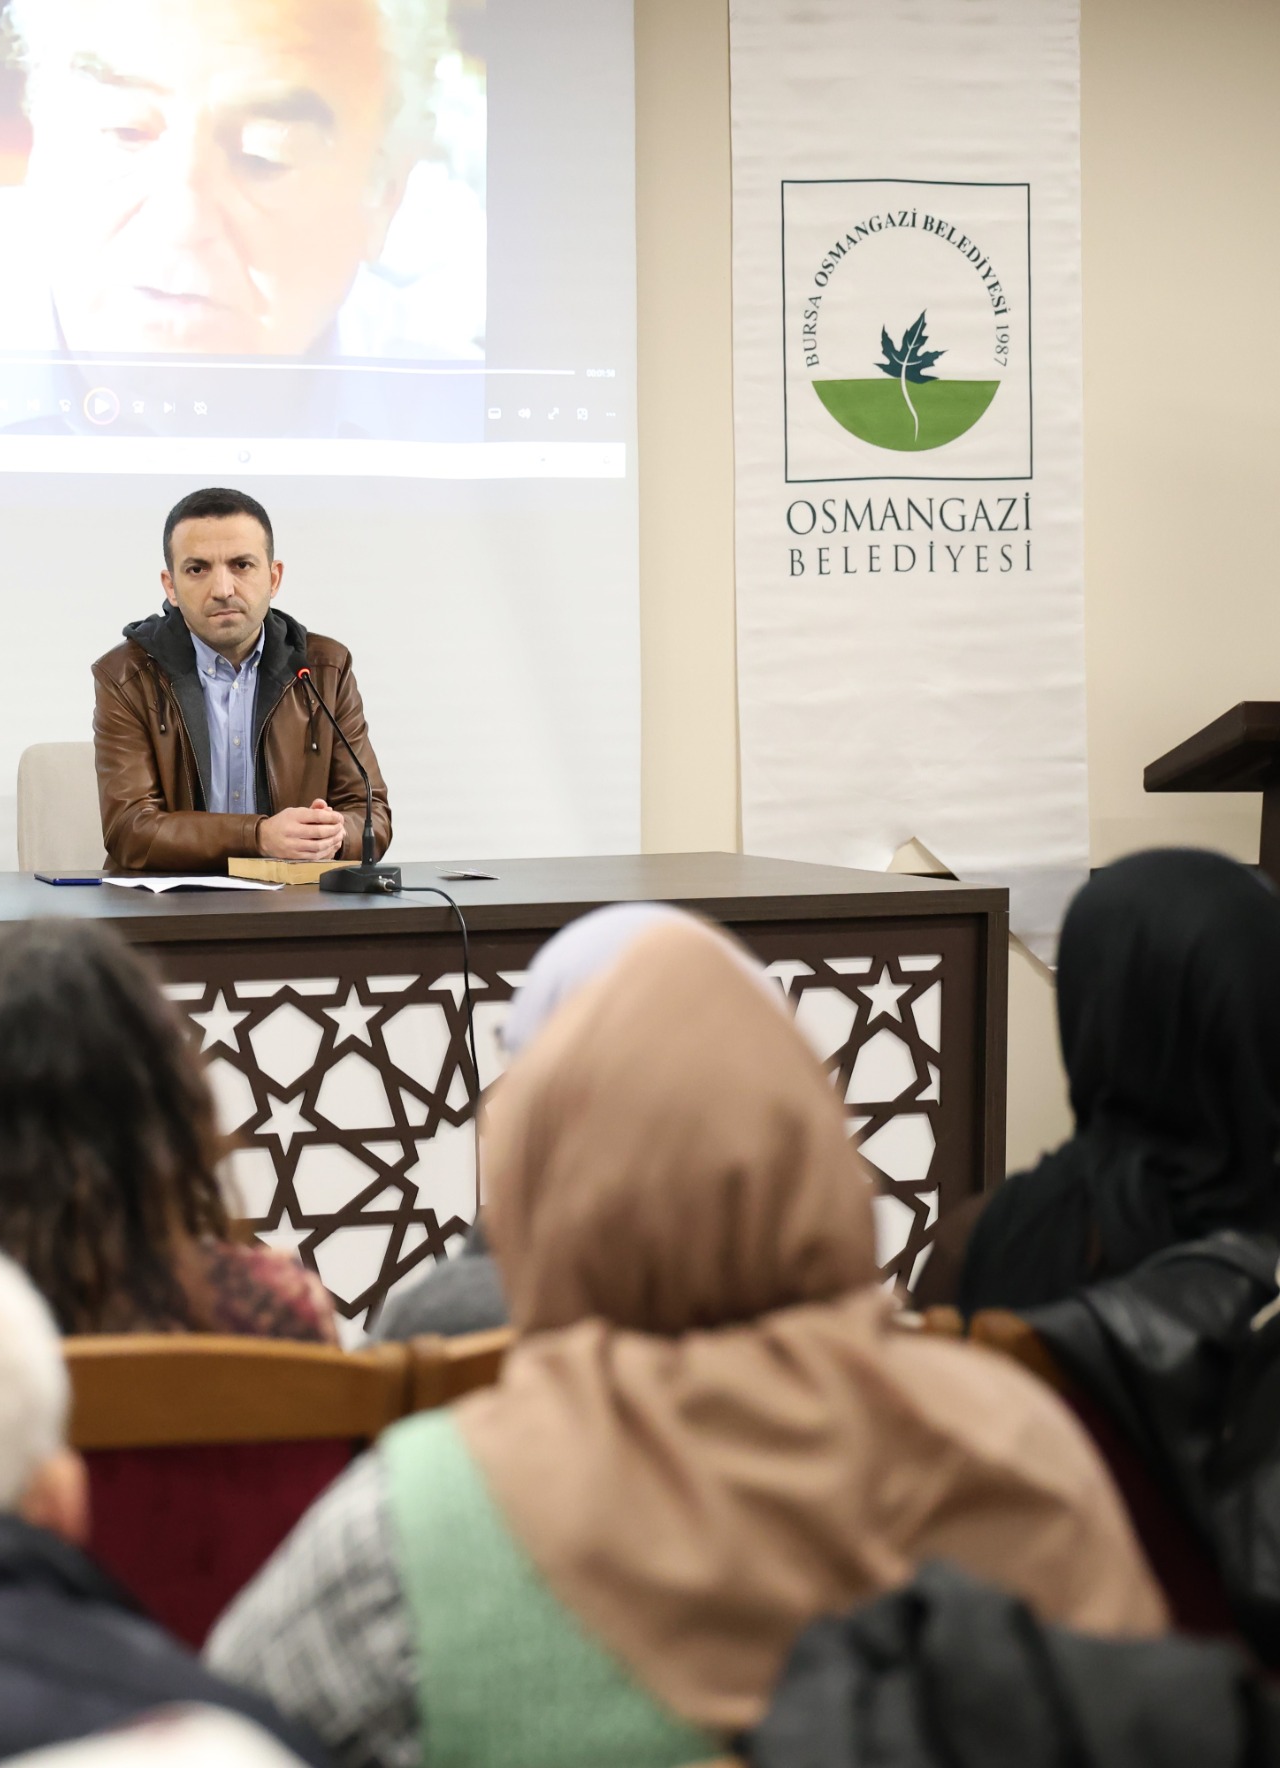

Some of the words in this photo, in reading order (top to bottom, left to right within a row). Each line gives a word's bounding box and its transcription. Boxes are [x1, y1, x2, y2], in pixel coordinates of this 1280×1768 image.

[803, 294, 823, 368] BURSA
[813, 208, 917, 288] OSMANGAZİ
[922, 214, 1010, 317] BELEDİYESİ
[994, 324, 1010, 367] 1987
[786, 492, 1032, 535] OSMANGAZİ
[789, 540, 1033, 577] BELEDİYESİ
